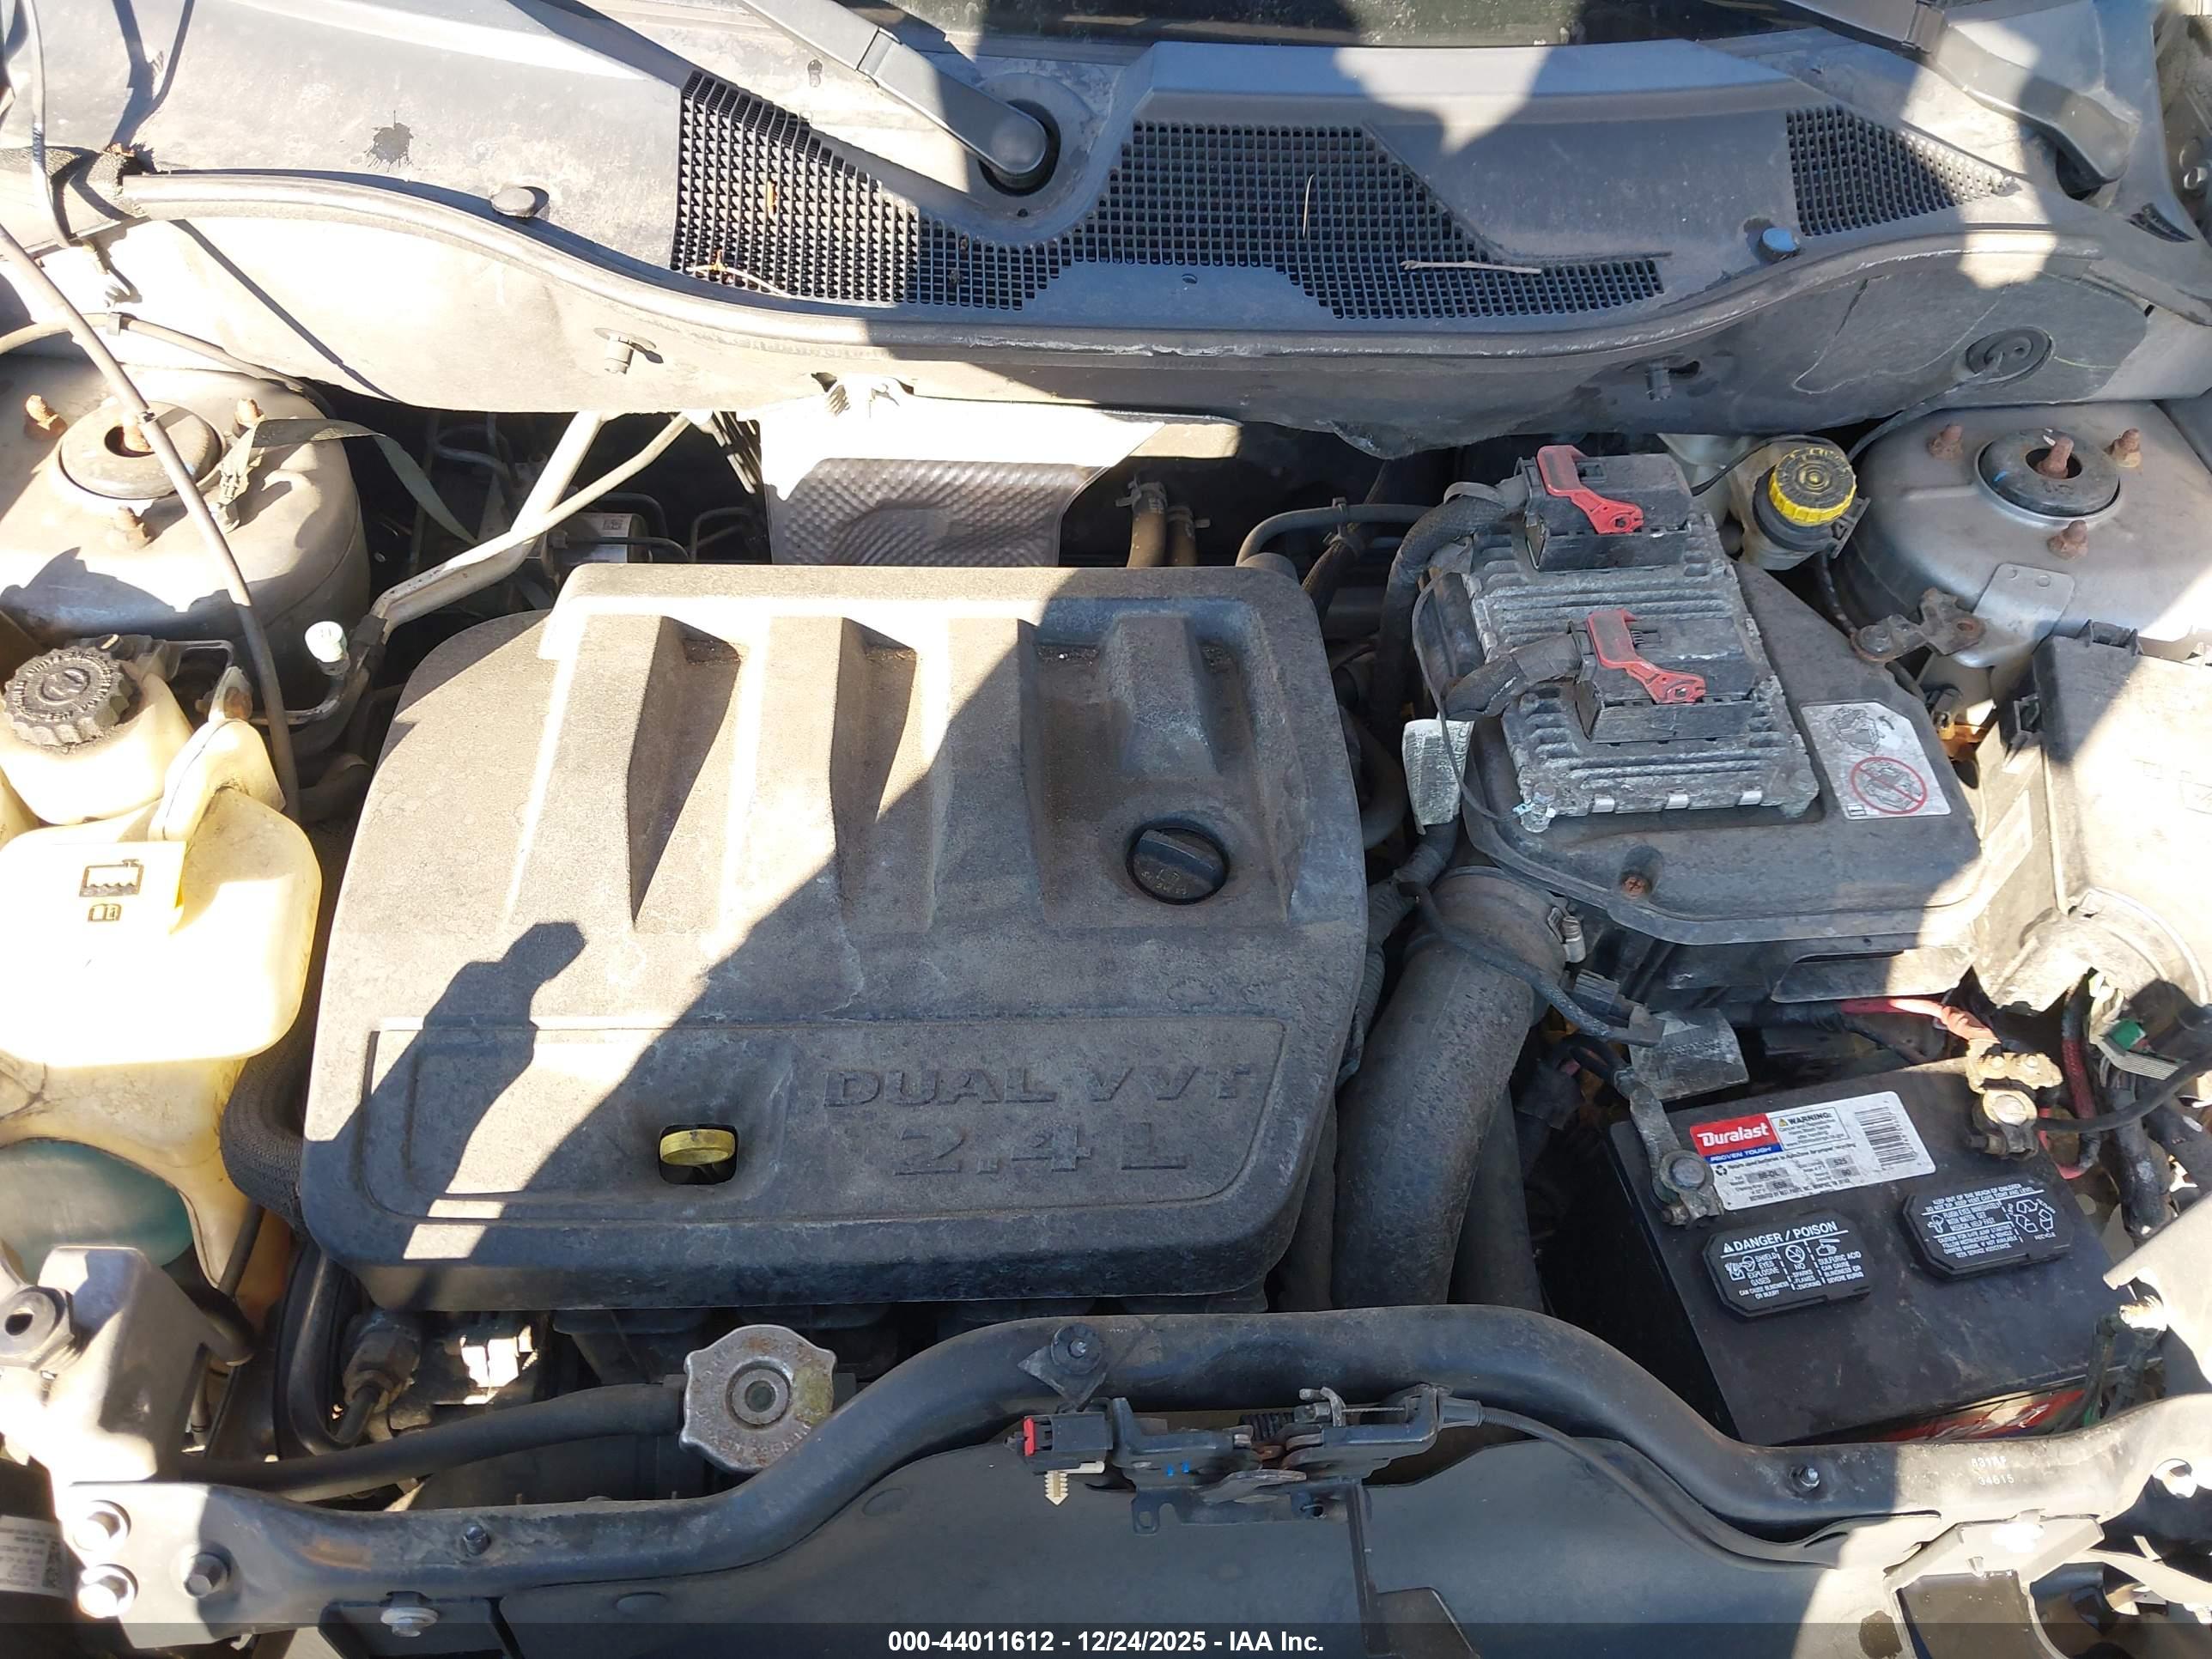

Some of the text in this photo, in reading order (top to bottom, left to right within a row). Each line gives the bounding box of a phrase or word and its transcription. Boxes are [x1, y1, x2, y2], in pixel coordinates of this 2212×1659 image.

[823, 1063, 1253, 1108] DUAL VVT
[1697, 1122, 1770, 1147] Duralast
[1711, 1147, 1772, 1162] PROVEN TOUGH
[1733, 1233, 1784, 1251] DANGER
[1792, 1221, 1838, 1238] POISON
[1754, 1252, 1778, 1262] SHIELD
[1818, 1251, 1862, 1265] SULFURIC ACID
[1758, 1261, 1774, 1269] EYES
[1832, 1261, 1850, 1269] CAUSE
[1747, 1267, 1780, 1279] EXPLOSIVE
[1824, 1267, 1852, 1277] BLINDNESS
[1826, 1271, 1864, 1284] SEVERE BURNS
[1751, 1277, 1771, 1286] GASES
